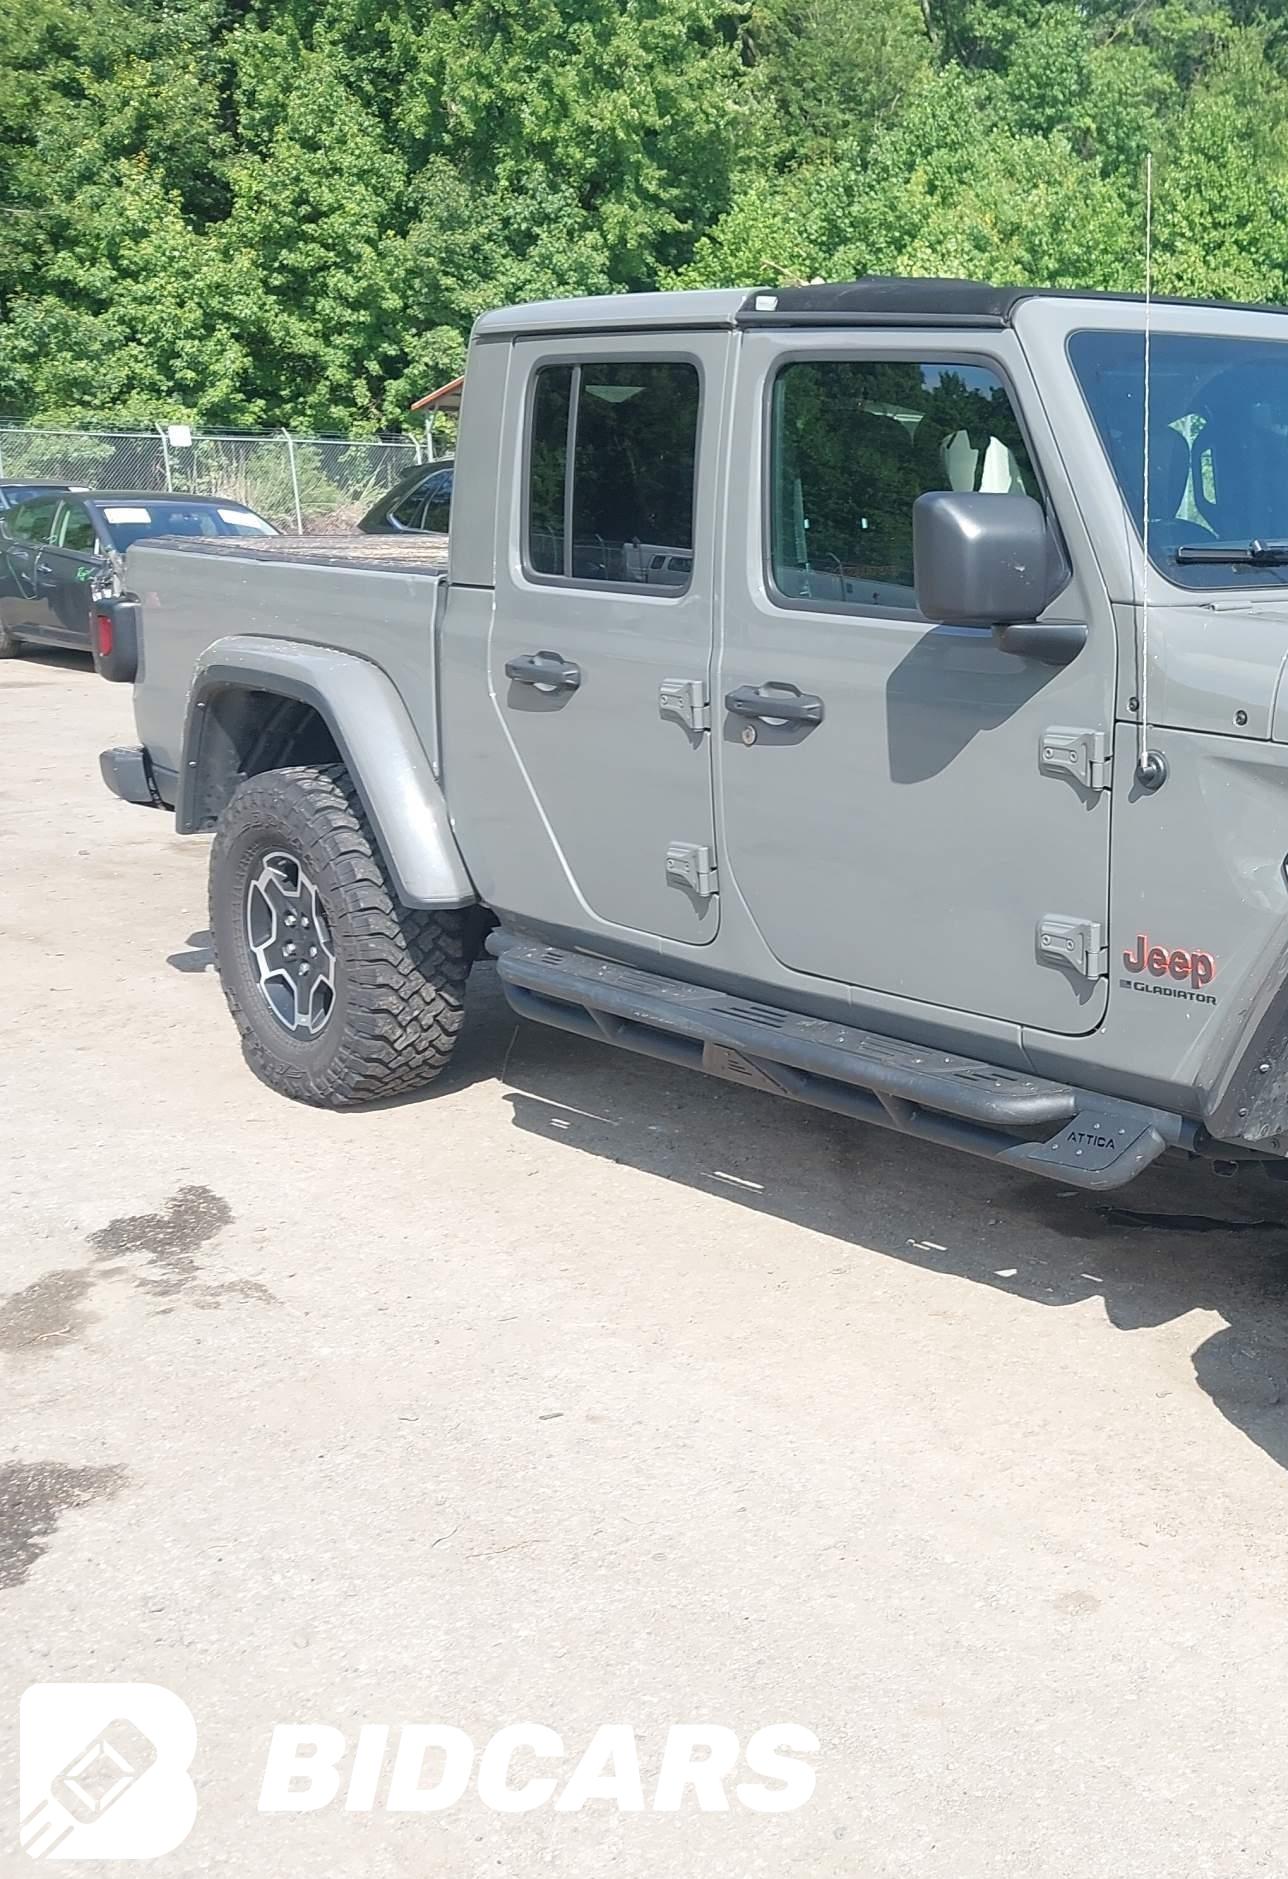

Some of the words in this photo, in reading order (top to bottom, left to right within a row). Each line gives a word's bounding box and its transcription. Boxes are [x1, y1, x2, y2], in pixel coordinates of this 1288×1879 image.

[1122, 935, 1217, 990] Jeep
[1132, 981, 1217, 1006] GLADIATOR
[1066, 1131, 1116, 1150] ATTICA
